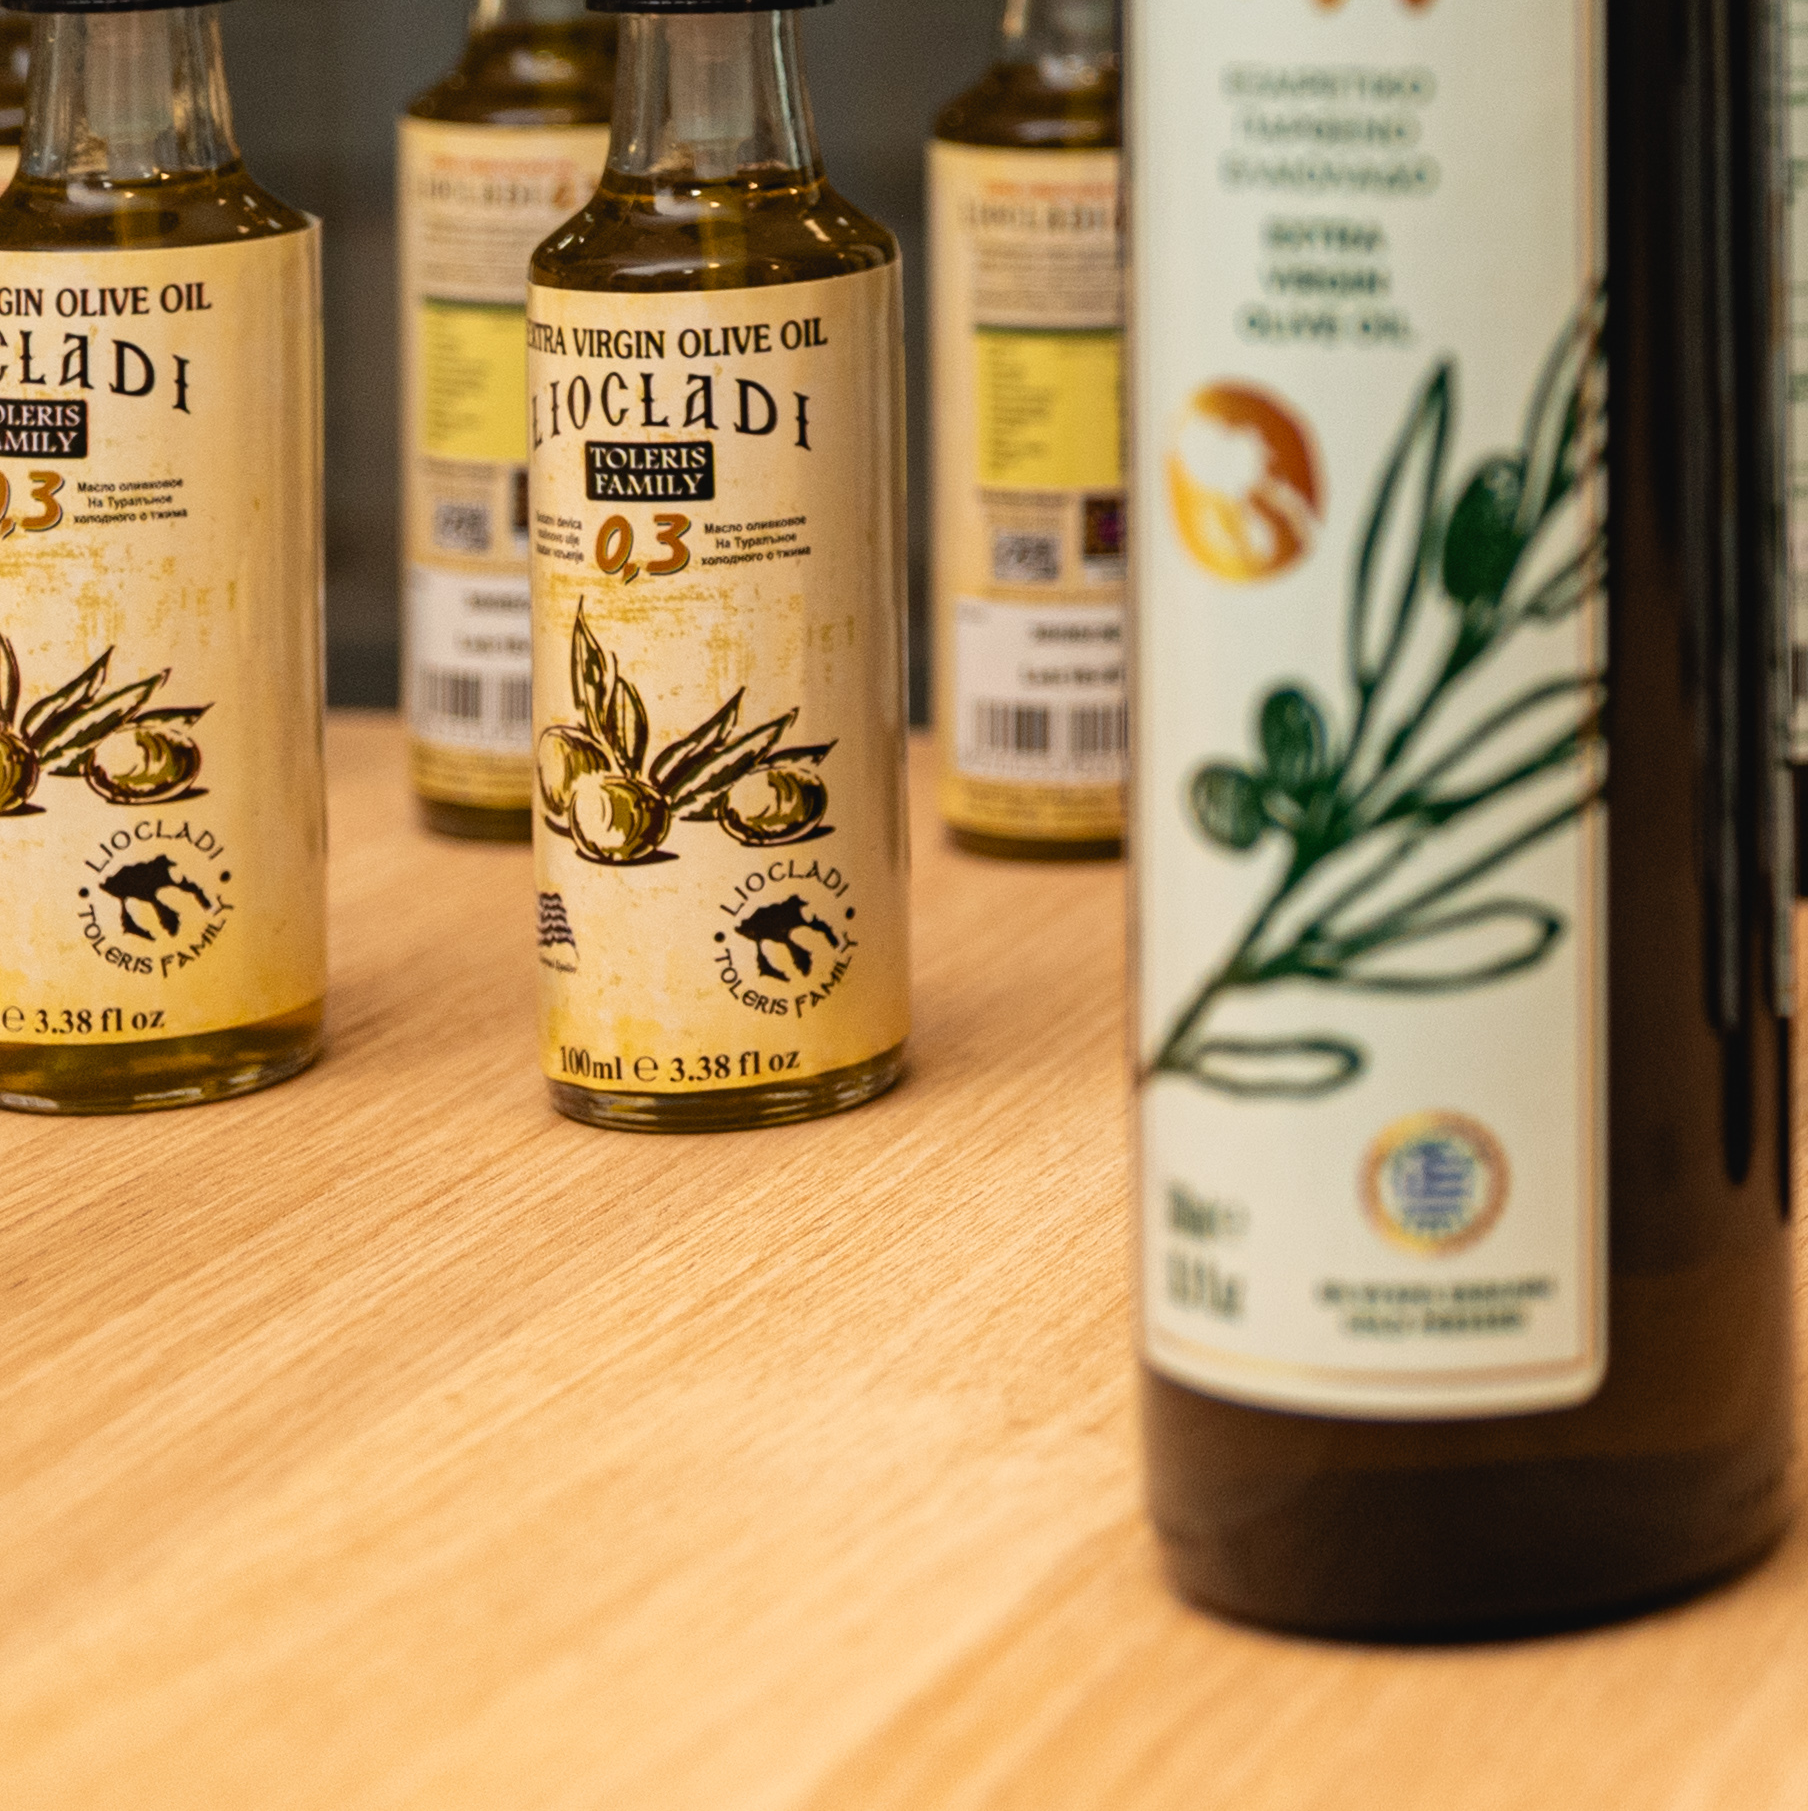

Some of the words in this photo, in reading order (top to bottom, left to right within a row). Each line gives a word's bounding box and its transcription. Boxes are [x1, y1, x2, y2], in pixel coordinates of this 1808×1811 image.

[55, 287, 149, 317] OLIVE
[160, 282, 212, 313] OIL
[572, 328, 665, 359] VIRGIN
[678, 323, 772, 358] OLIVE
[780, 317, 828, 350] OIL
[0, 405, 81, 427] LERIS
[0, 432, 78, 453] MILY
[589, 446, 707, 470] TOLERIS
[594, 473, 704, 496] FAMILY
[704, 523, 743, 534] Масло
[595, 514, 692, 585] 0,3
[85, 819, 224, 875] LIOCLADI
[720, 859, 849, 917] LIOCLADI
[78, 903, 153, 975] TOLERIS
[162, 894, 235, 978] FAMILY
[714, 948, 788, 1016] TOLERIS
[795, 932, 858, 1018] FAMILY
[34, 1008, 92, 1035] 3.38
[101, 1008, 124, 1032] fl
[131, 1008, 166, 1031] oz
[560, 1046, 622, 1081] 100ml
[669, 1054, 731, 1082] 3.38
[739, 1050, 762, 1076] fl
[769, 1050, 800, 1071] oz
